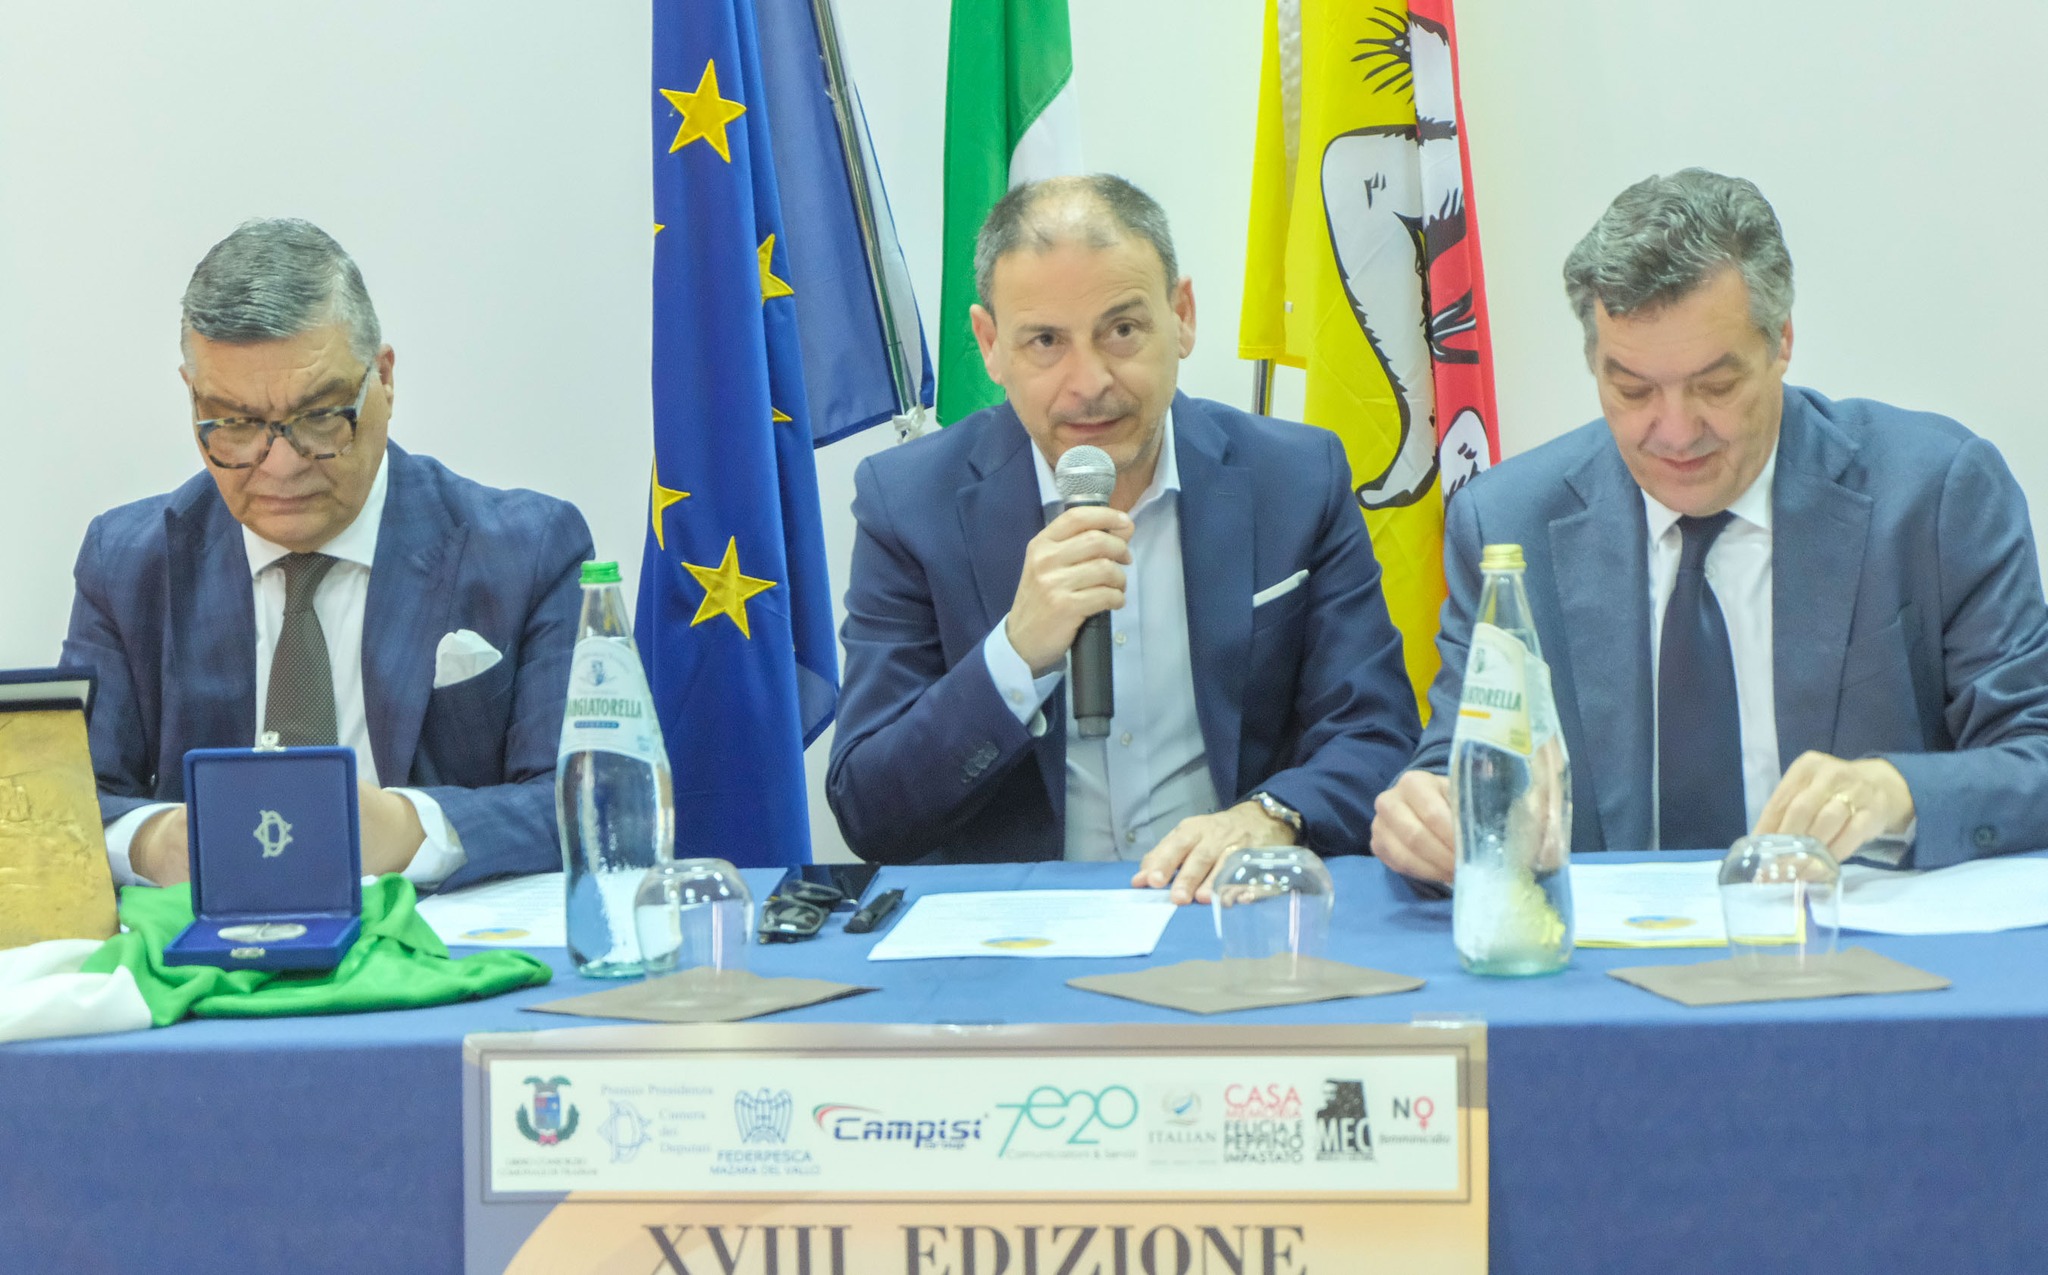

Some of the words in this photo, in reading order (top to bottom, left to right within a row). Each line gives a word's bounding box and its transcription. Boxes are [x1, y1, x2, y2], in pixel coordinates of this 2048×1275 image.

[1224, 1083, 1302, 1108] CASA
[834, 1117, 981, 1148] Campisi
[1148, 1130, 1217, 1144] ITALIAN
[717, 1150, 813, 1162] FEDERPESCA
[642, 1223, 852, 1275] XVIII
[898, 1223, 1306, 1275] EDIZIONE
